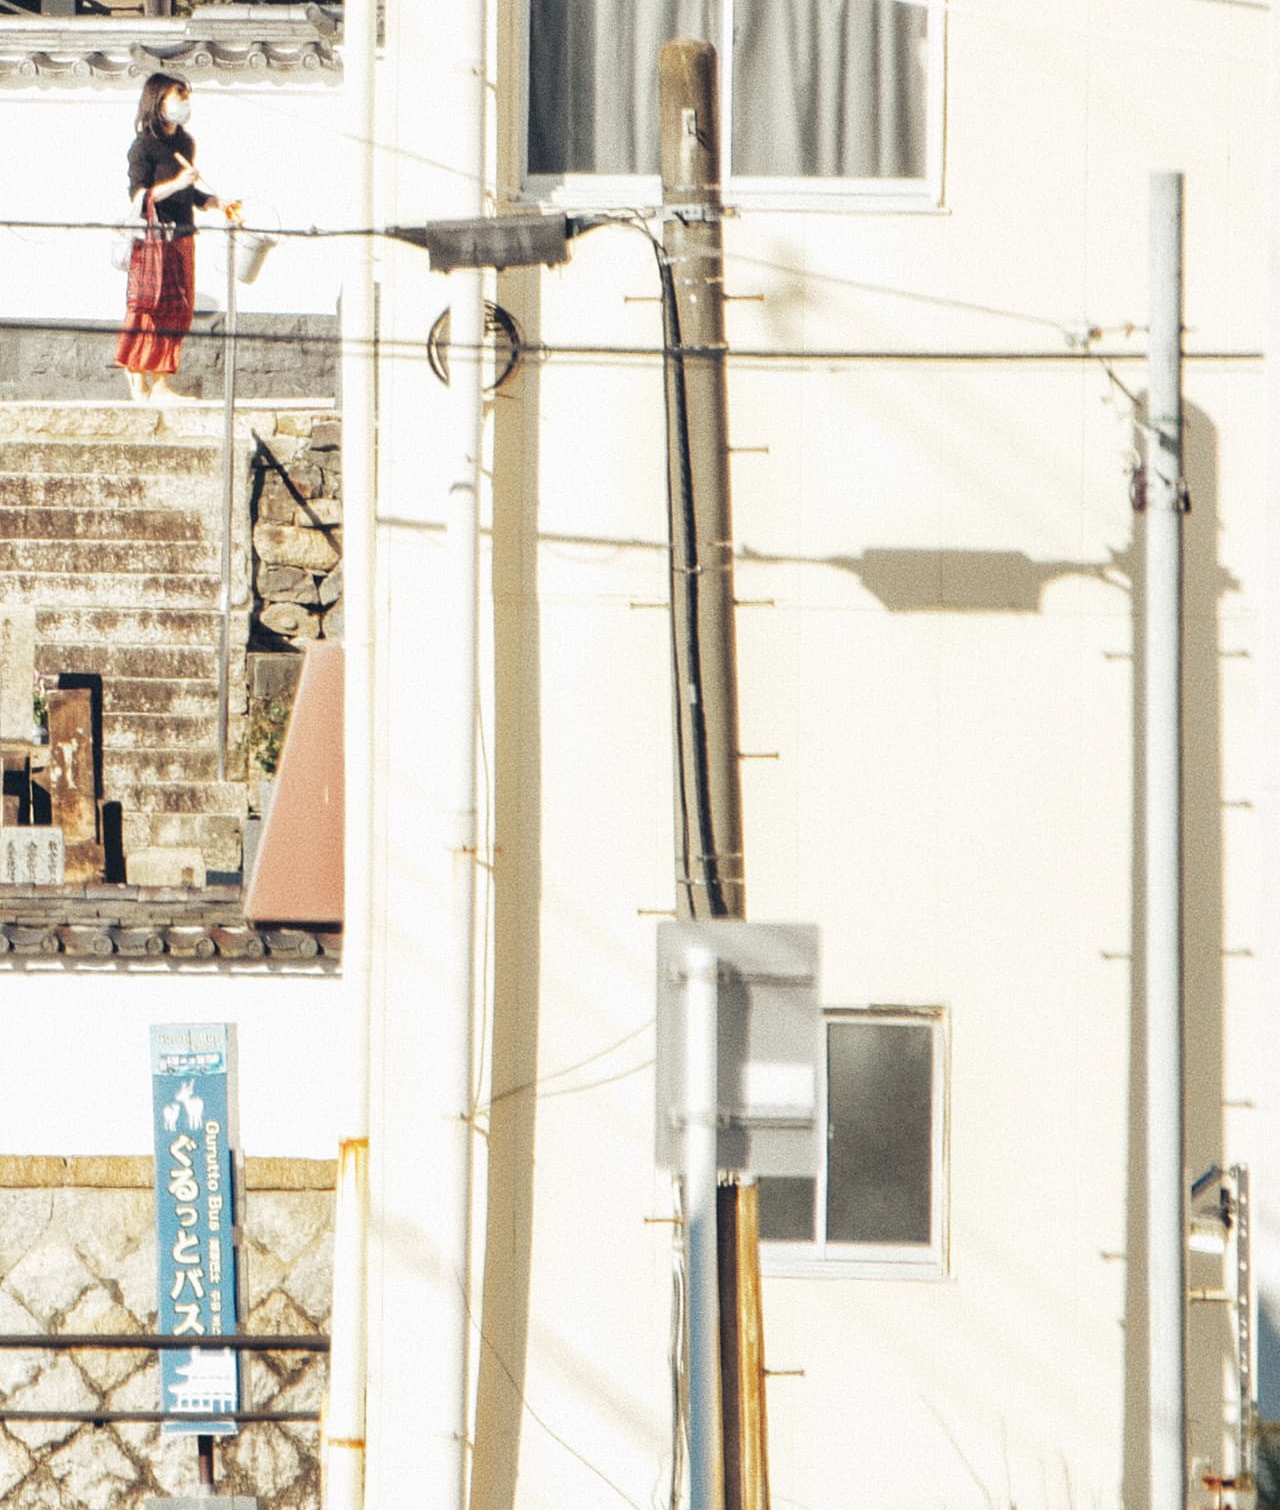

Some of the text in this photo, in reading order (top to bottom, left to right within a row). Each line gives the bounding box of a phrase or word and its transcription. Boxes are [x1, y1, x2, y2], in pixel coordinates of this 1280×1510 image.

[168, 1134, 206, 1336] ぐるっとバス
[207, 1195, 223, 1231] Bus
